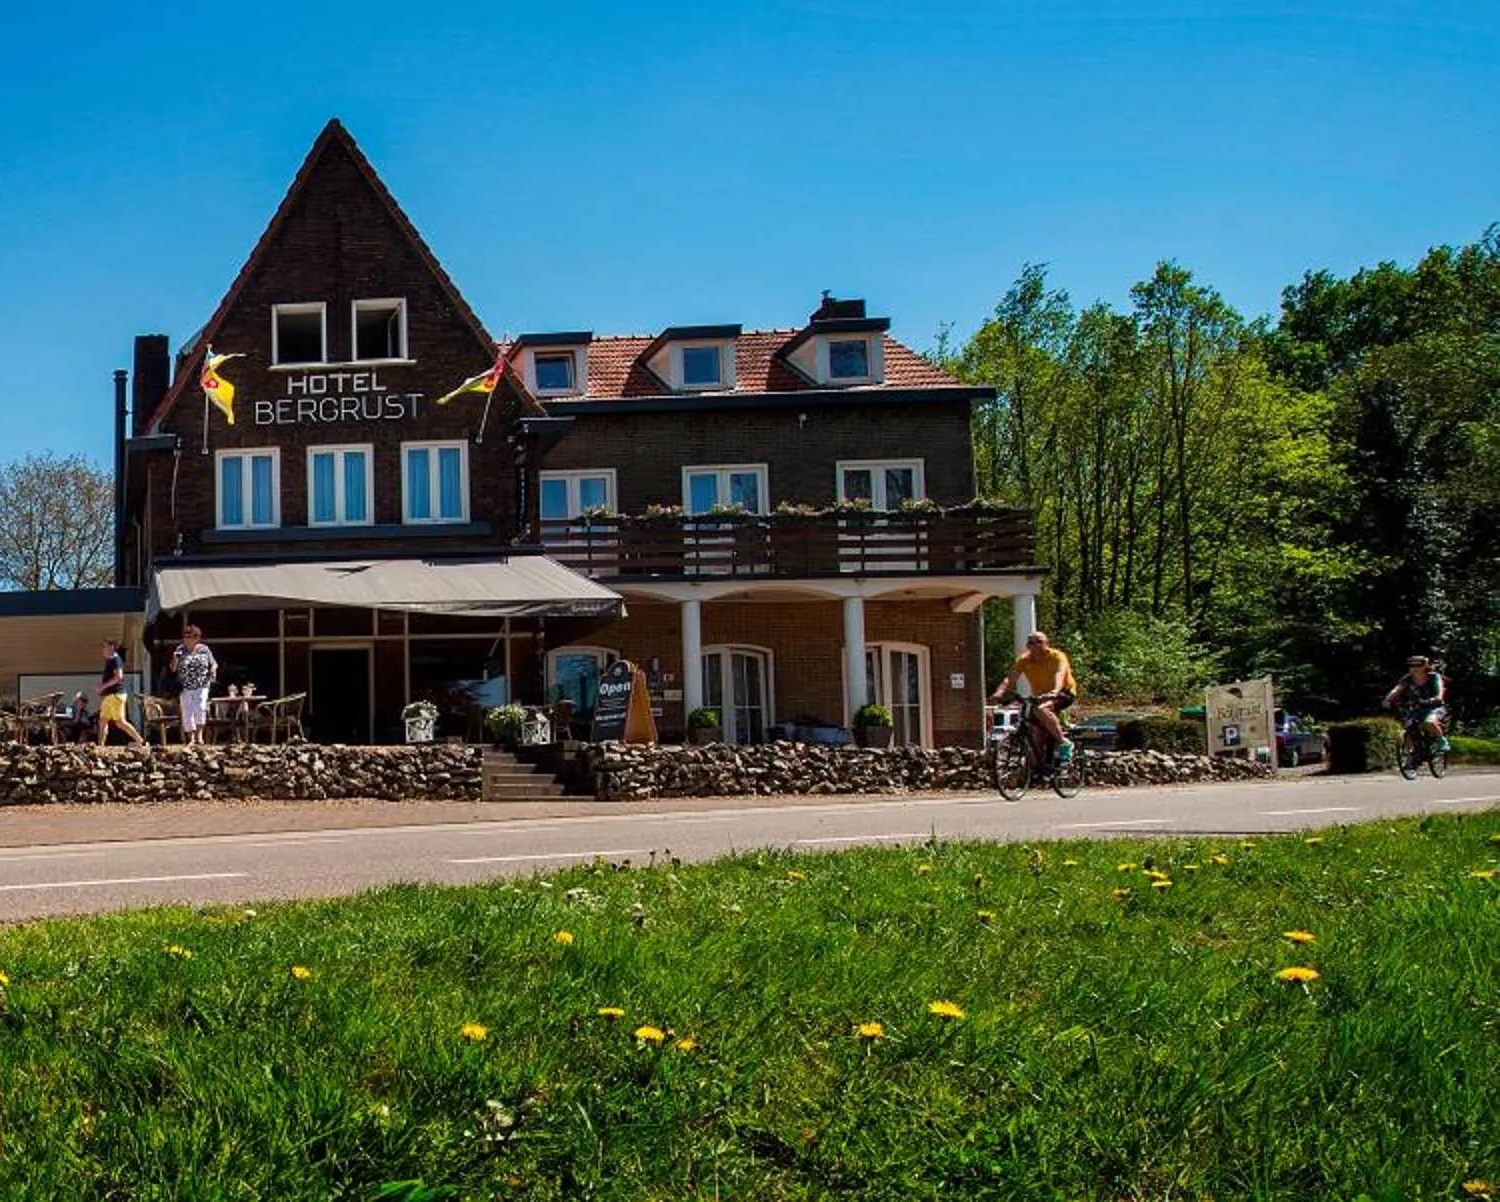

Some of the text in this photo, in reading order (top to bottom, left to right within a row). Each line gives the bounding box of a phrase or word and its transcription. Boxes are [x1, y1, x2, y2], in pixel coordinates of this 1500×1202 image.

[287, 372, 387, 395] HOTEL
[255, 393, 424, 425] BERGRUST
[600, 681, 631, 696] Open
[1226, 727, 1237, 745] P
